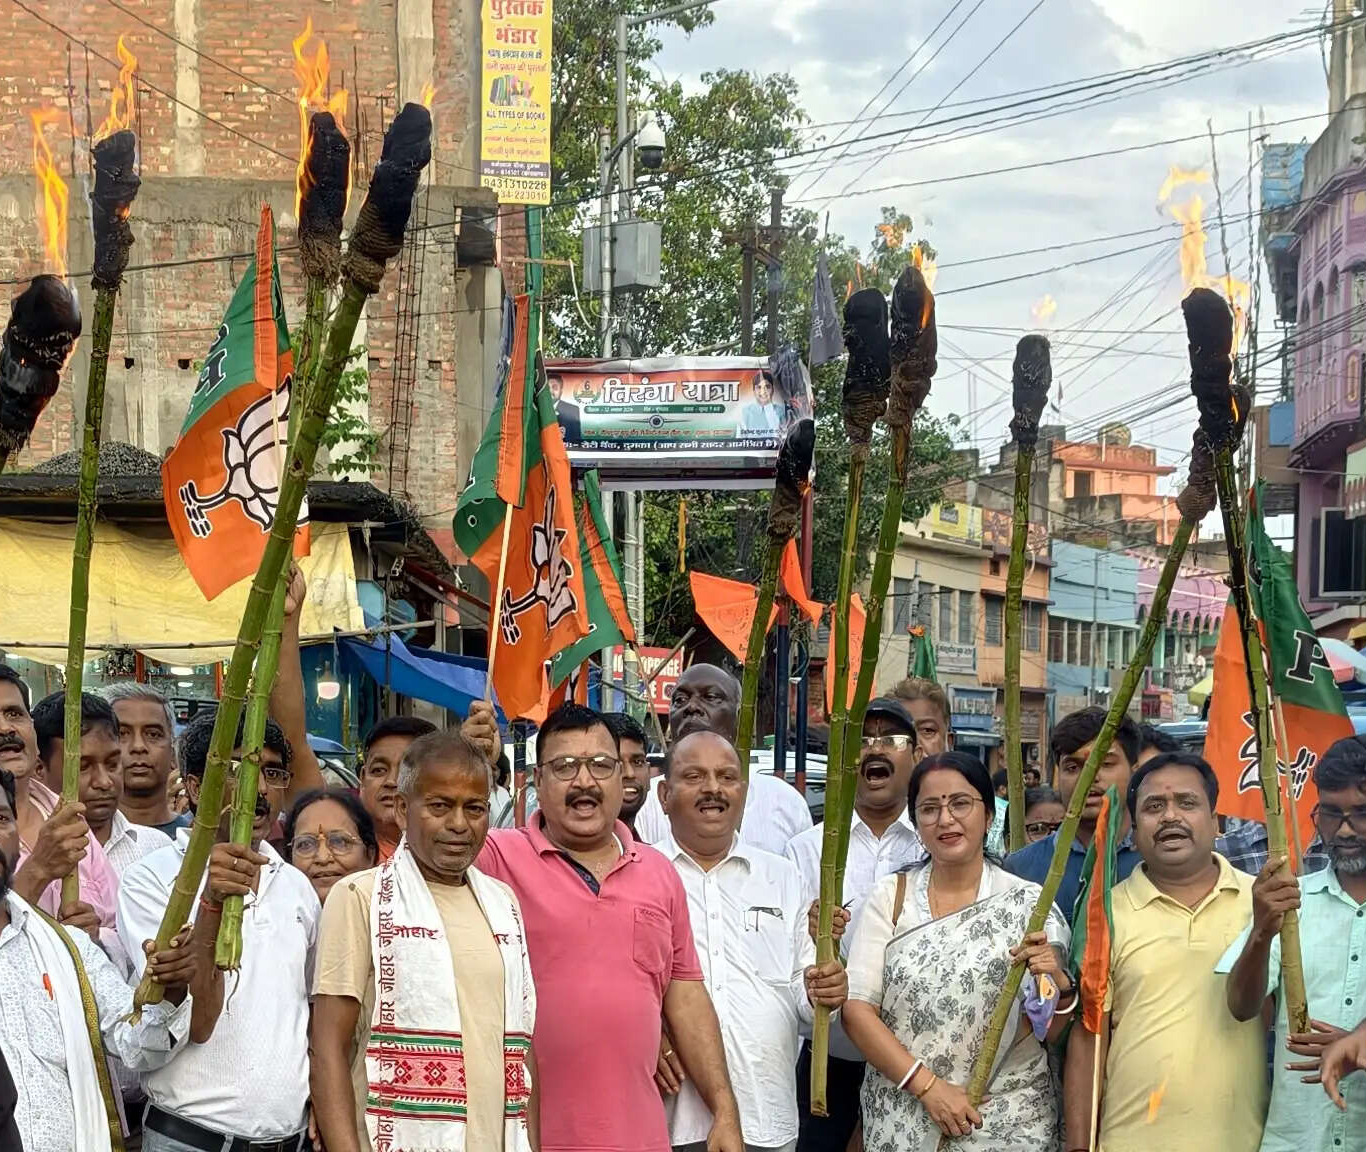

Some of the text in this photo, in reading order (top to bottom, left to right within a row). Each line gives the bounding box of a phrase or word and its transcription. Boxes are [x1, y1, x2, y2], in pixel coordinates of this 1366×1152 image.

[496, 24, 538, 44] भंडार
[498, 110, 515, 119] TYPES
[517, 111, 525, 119] OF
[526, 112, 545, 121] BOOKS
[483, 178, 547, 191] 9431310228
[603, 377, 740, 403] तिरंगा यात्रा
[623, 442, 651, 451] दुमका
[653, 441, 676, 451] (आप
[678, 441, 698, 449] सभी
[376, 909, 394, 949] जोहार
[393, 925, 439, 940] जोहार
[378, 953, 395, 994] जोहार
